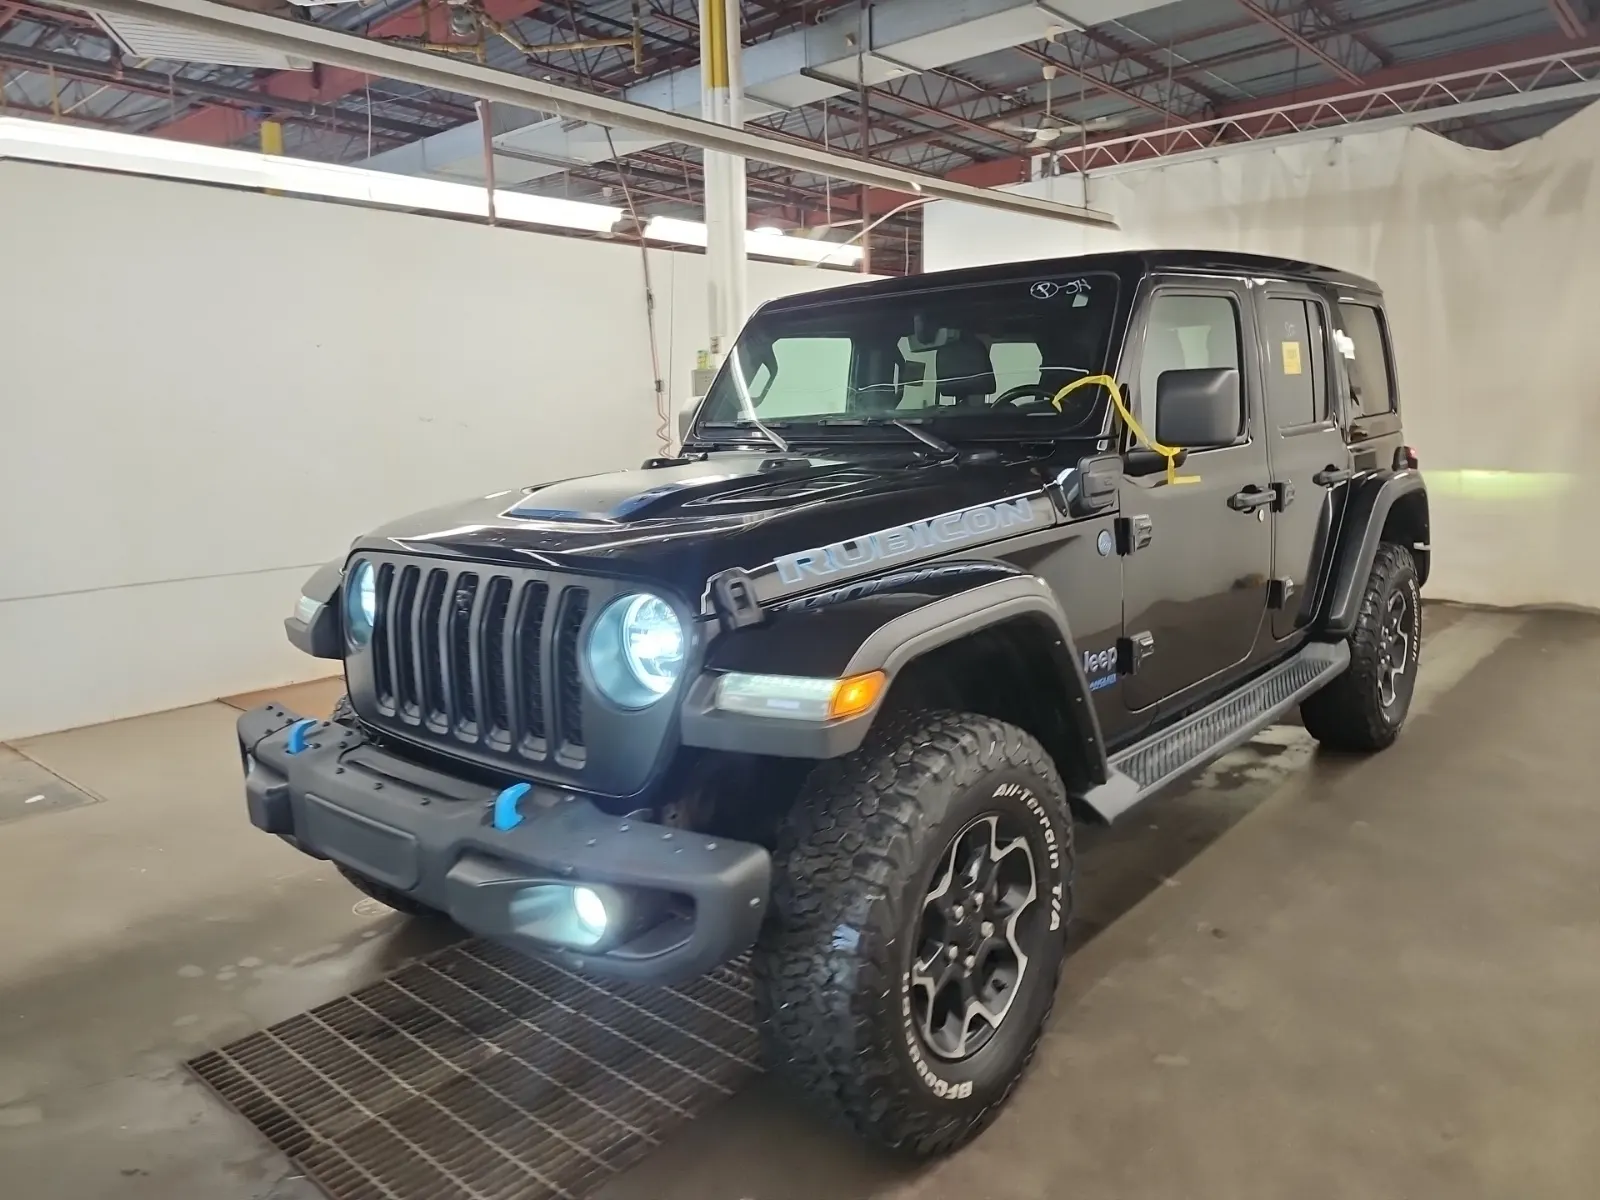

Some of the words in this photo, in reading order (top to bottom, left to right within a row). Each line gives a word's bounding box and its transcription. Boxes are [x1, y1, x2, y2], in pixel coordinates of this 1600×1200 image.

[772, 497, 1034, 585] RUBICON
[992, 783, 1060, 869] All-Terrain
[1050, 882, 1063, 932] T/A
